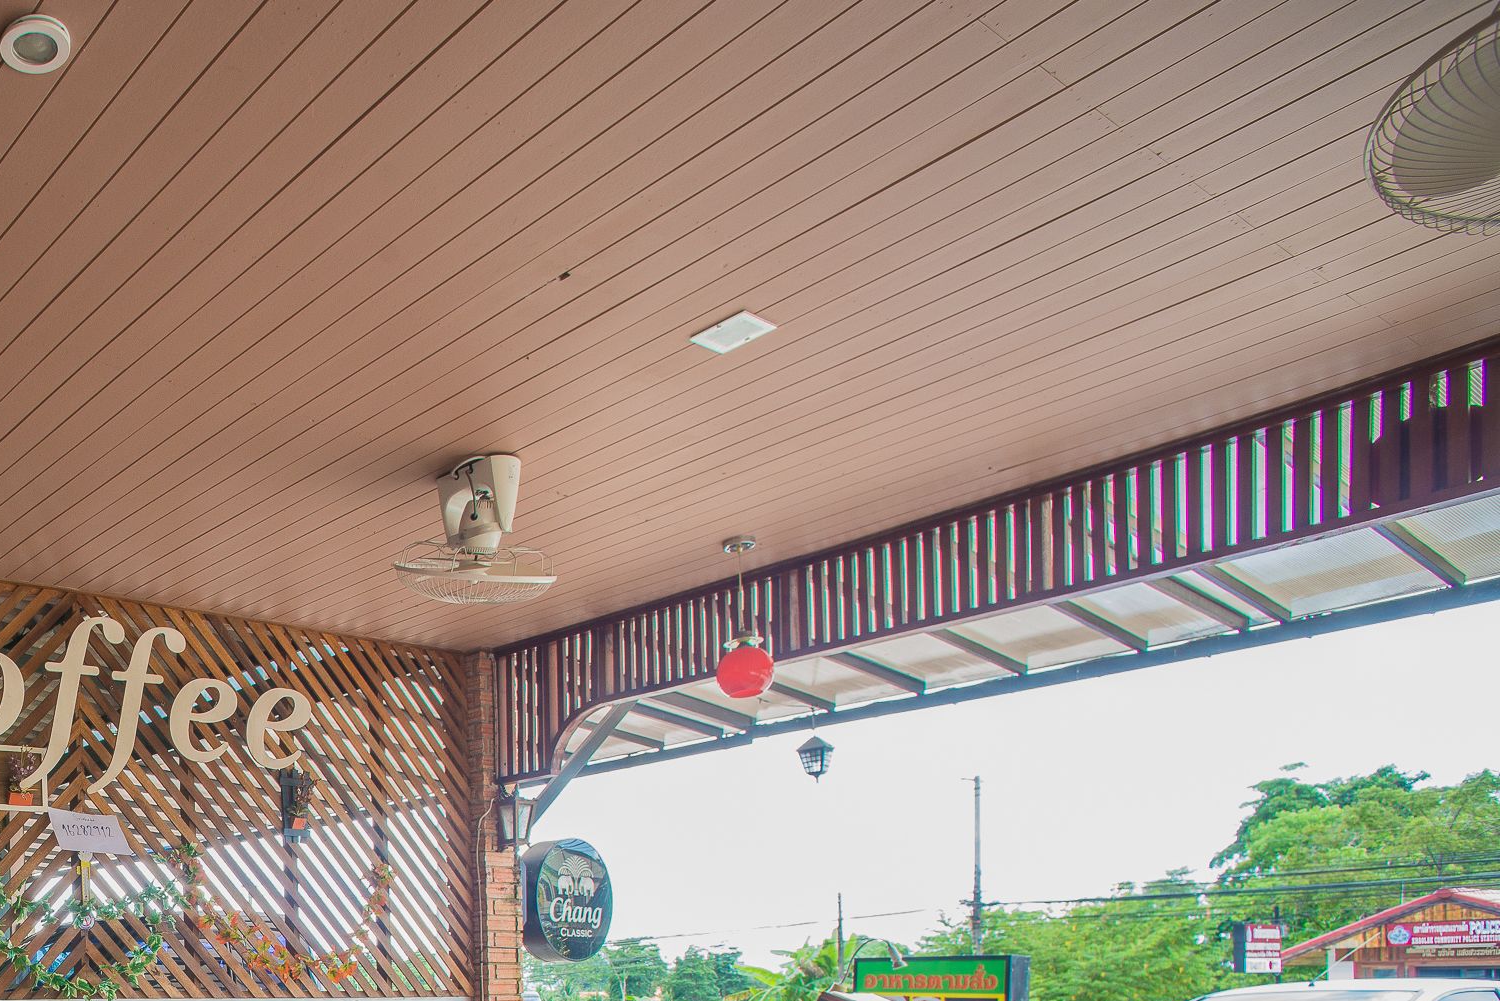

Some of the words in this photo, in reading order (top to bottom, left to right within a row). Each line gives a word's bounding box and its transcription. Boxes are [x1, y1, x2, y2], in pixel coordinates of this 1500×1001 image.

[549, 896, 603, 929] Chang
[864, 964, 999, 990] อาหารตามสั่ง
